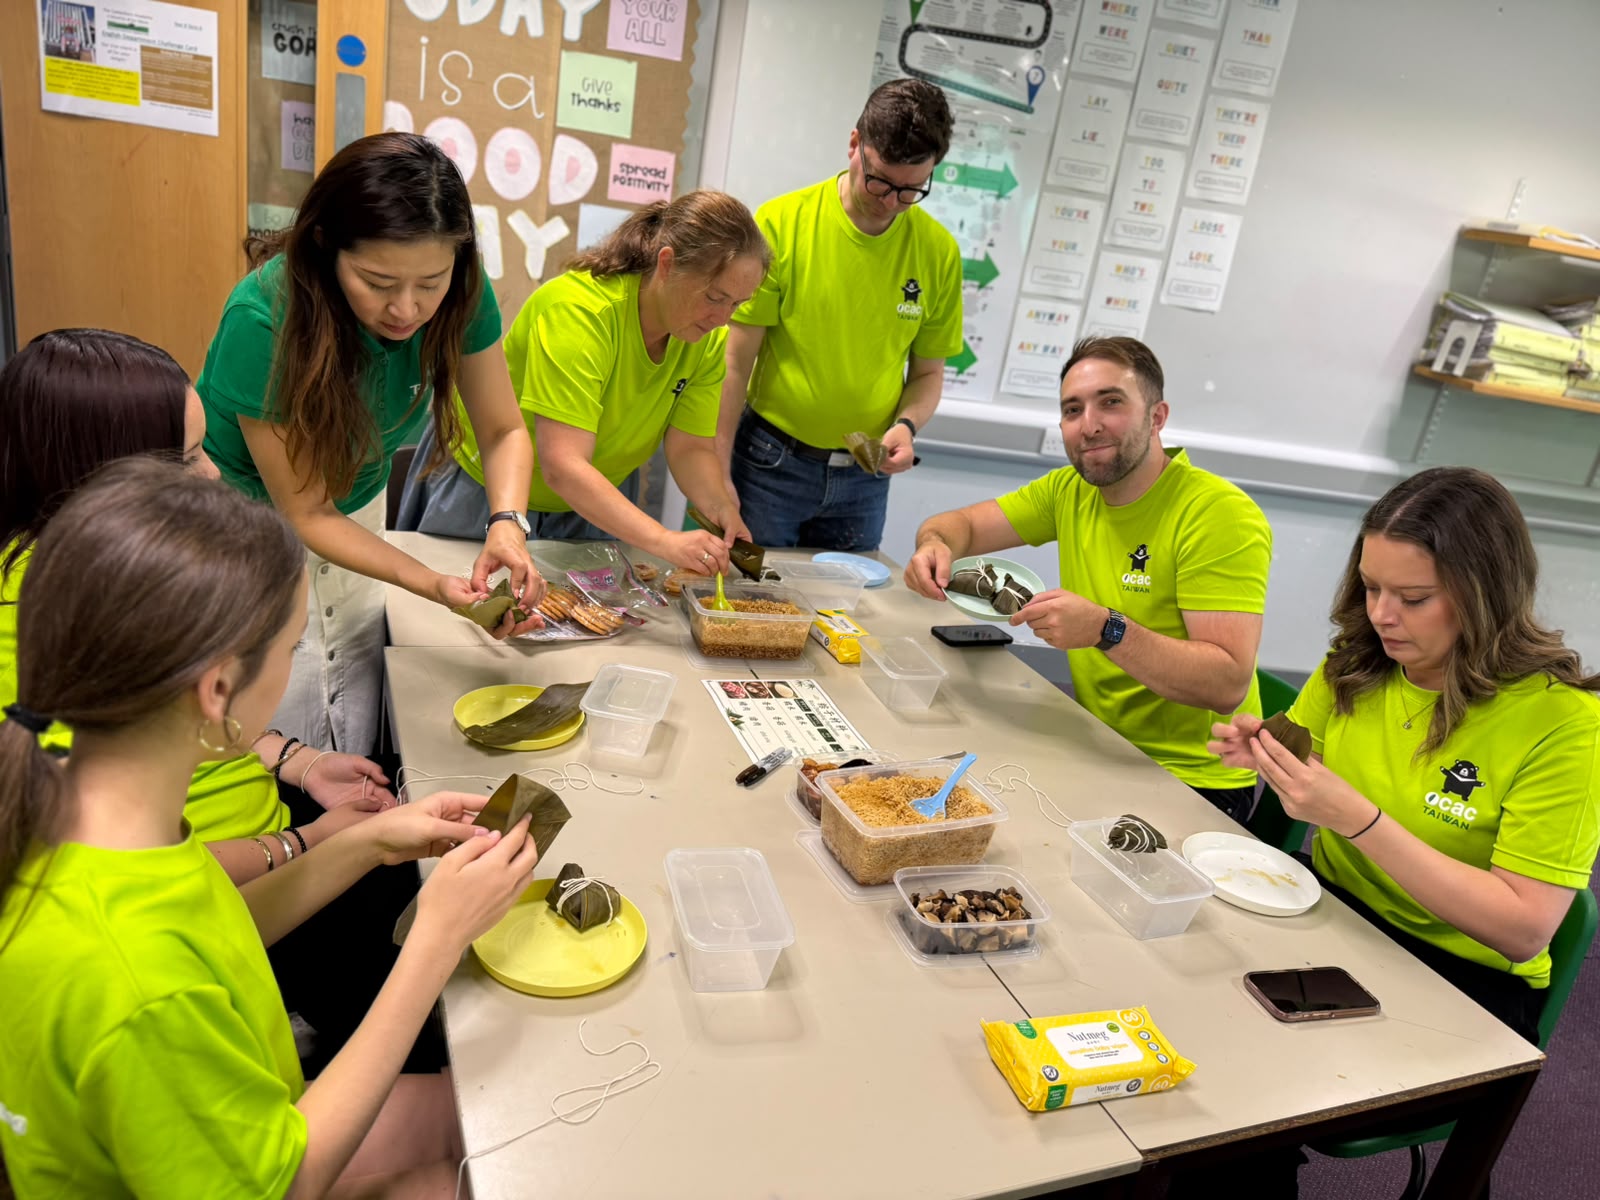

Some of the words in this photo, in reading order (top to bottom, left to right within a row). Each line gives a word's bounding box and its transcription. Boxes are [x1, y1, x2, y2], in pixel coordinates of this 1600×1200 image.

[621, 0, 677, 22] YOUR
[1101, 0, 1138, 17] WHERE
[625, 17, 665, 46] ALL
[1099, 25, 1129, 40] WERE
[1243, 29, 1272, 44] THAN
[1166, 42, 1196, 57] QUIET
[420, 36, 473, 106] is
[493, 72, 545, 119] a
[1157, 79, 1188, 93] QUITE
[1087, 96, 1108, 108] LAY
[1082, 130, 1098, 142] LIE
[1145, 156, 1164, 168] TOO
[1210, 153, 1243, 169] THERE
[613, 175, 670, 193] POSITIVITY
[1142, 179, 1155, 190] TO
[1134, 201, 1154, 213] TWO
[1193, 219, 1225, 234] LOOSE
[1052, 239, 1078, 252] YOUR
[1189, 251, 1214, 264] LOSE
[1105, 296, 1140, 310] WHOSE
[1027, 309, 1070, 324] ANYWAY
[1018, 342, 1037, 352] ANY
[1043, 344, 1064, 356] WAY
[1122, 585, 1150, 593] TAIWAN
[1423, 806, 1470, 830] TAIWAN
[1067, 1031, 1110, 1042] Nutmeg
[1095, 1083, 1121, 1093] Nutmeg
